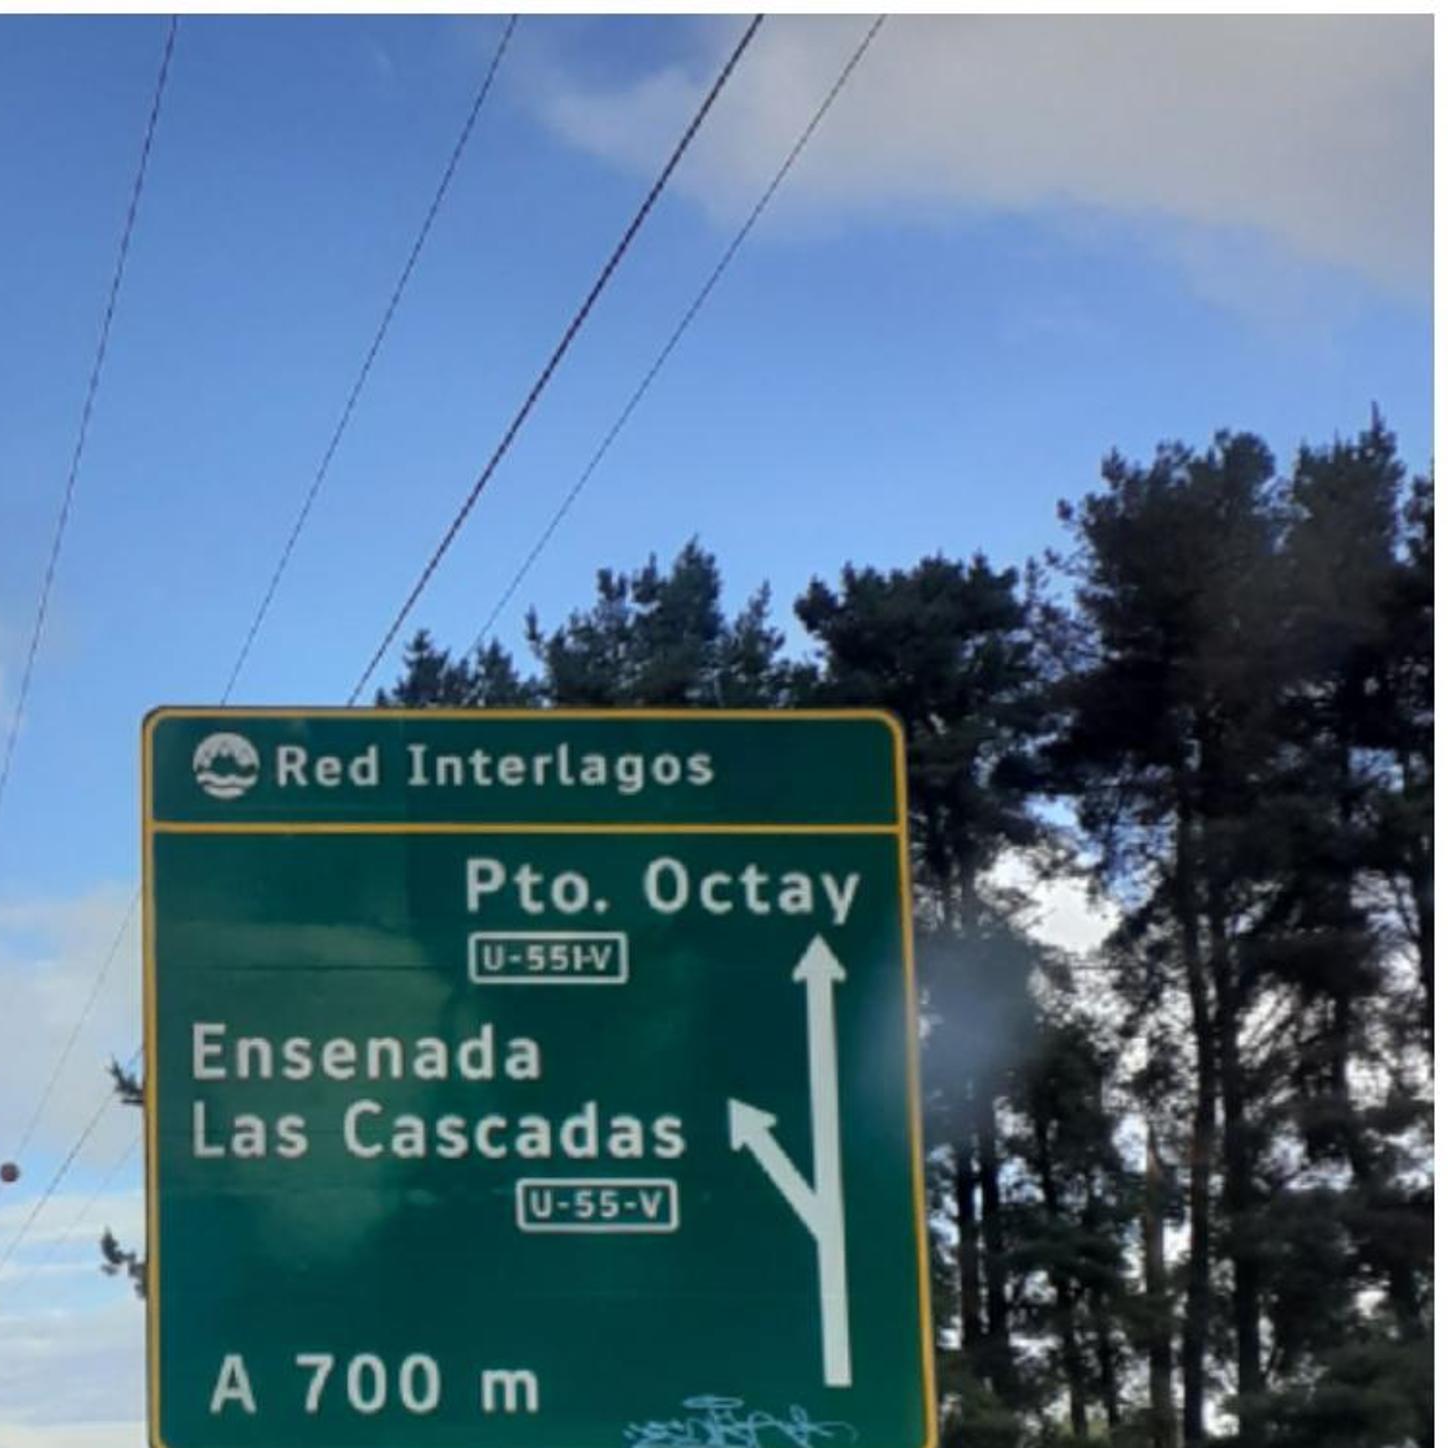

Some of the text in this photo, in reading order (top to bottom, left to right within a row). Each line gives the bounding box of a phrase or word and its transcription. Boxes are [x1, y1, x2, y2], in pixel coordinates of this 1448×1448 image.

[276, 743, 714, 795] Red Interlagos
[466, 857, 860, 925] Pto. Octay
[483, 943, 612, 971] U-551-V
[193, 1022, 540, 1081] Ensenada
[193, 1098, 685, 1159] Las Cascadas
[530, 1188, 662, 1219] U-55-V
[210, 1353, 539, 1413] A 700 m
